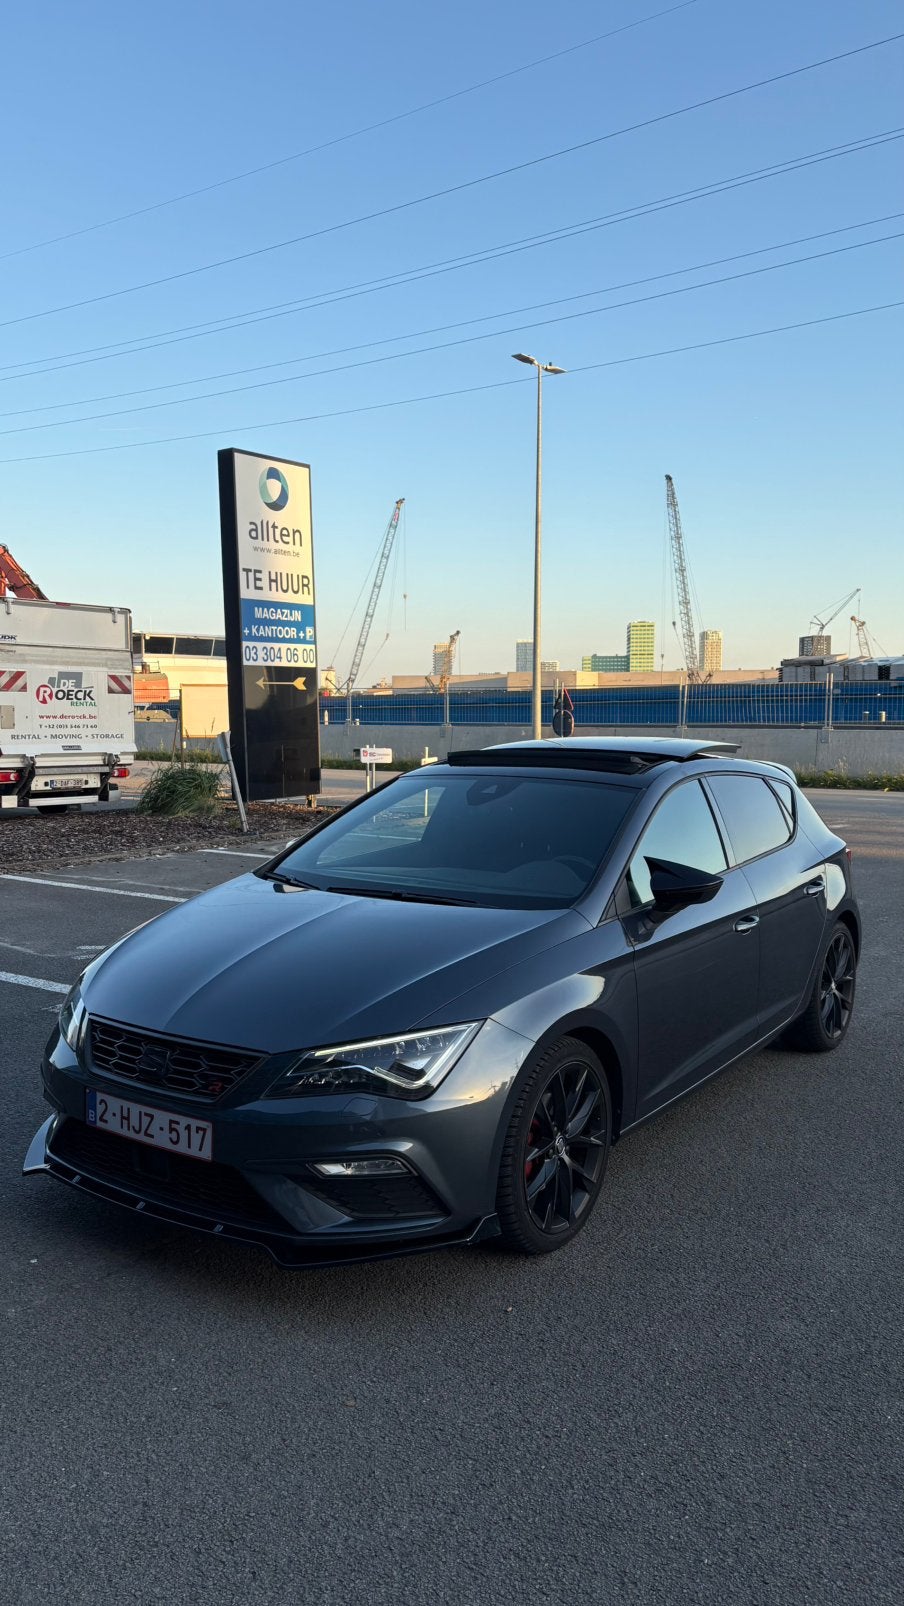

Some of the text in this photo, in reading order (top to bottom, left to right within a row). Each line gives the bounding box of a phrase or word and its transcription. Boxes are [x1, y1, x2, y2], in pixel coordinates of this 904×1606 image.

[248, 519, 303, 547] allten
[253, 546, 300, 557] www.allten.be
[242, 567, 311, 596] TE HUUR
[254, 606, 302, 622] MAGAZIJN
[251, 625, 297, 639] KANTOOR
[306, 628, 313, 640] P
[244, 645, 315, 664] 03 304 06 00
[60, 679, 76, 689] DE
[38, 686, 95, 702] ROECK
[88, 1099, 208, 1152] B 2-HJZ-517
